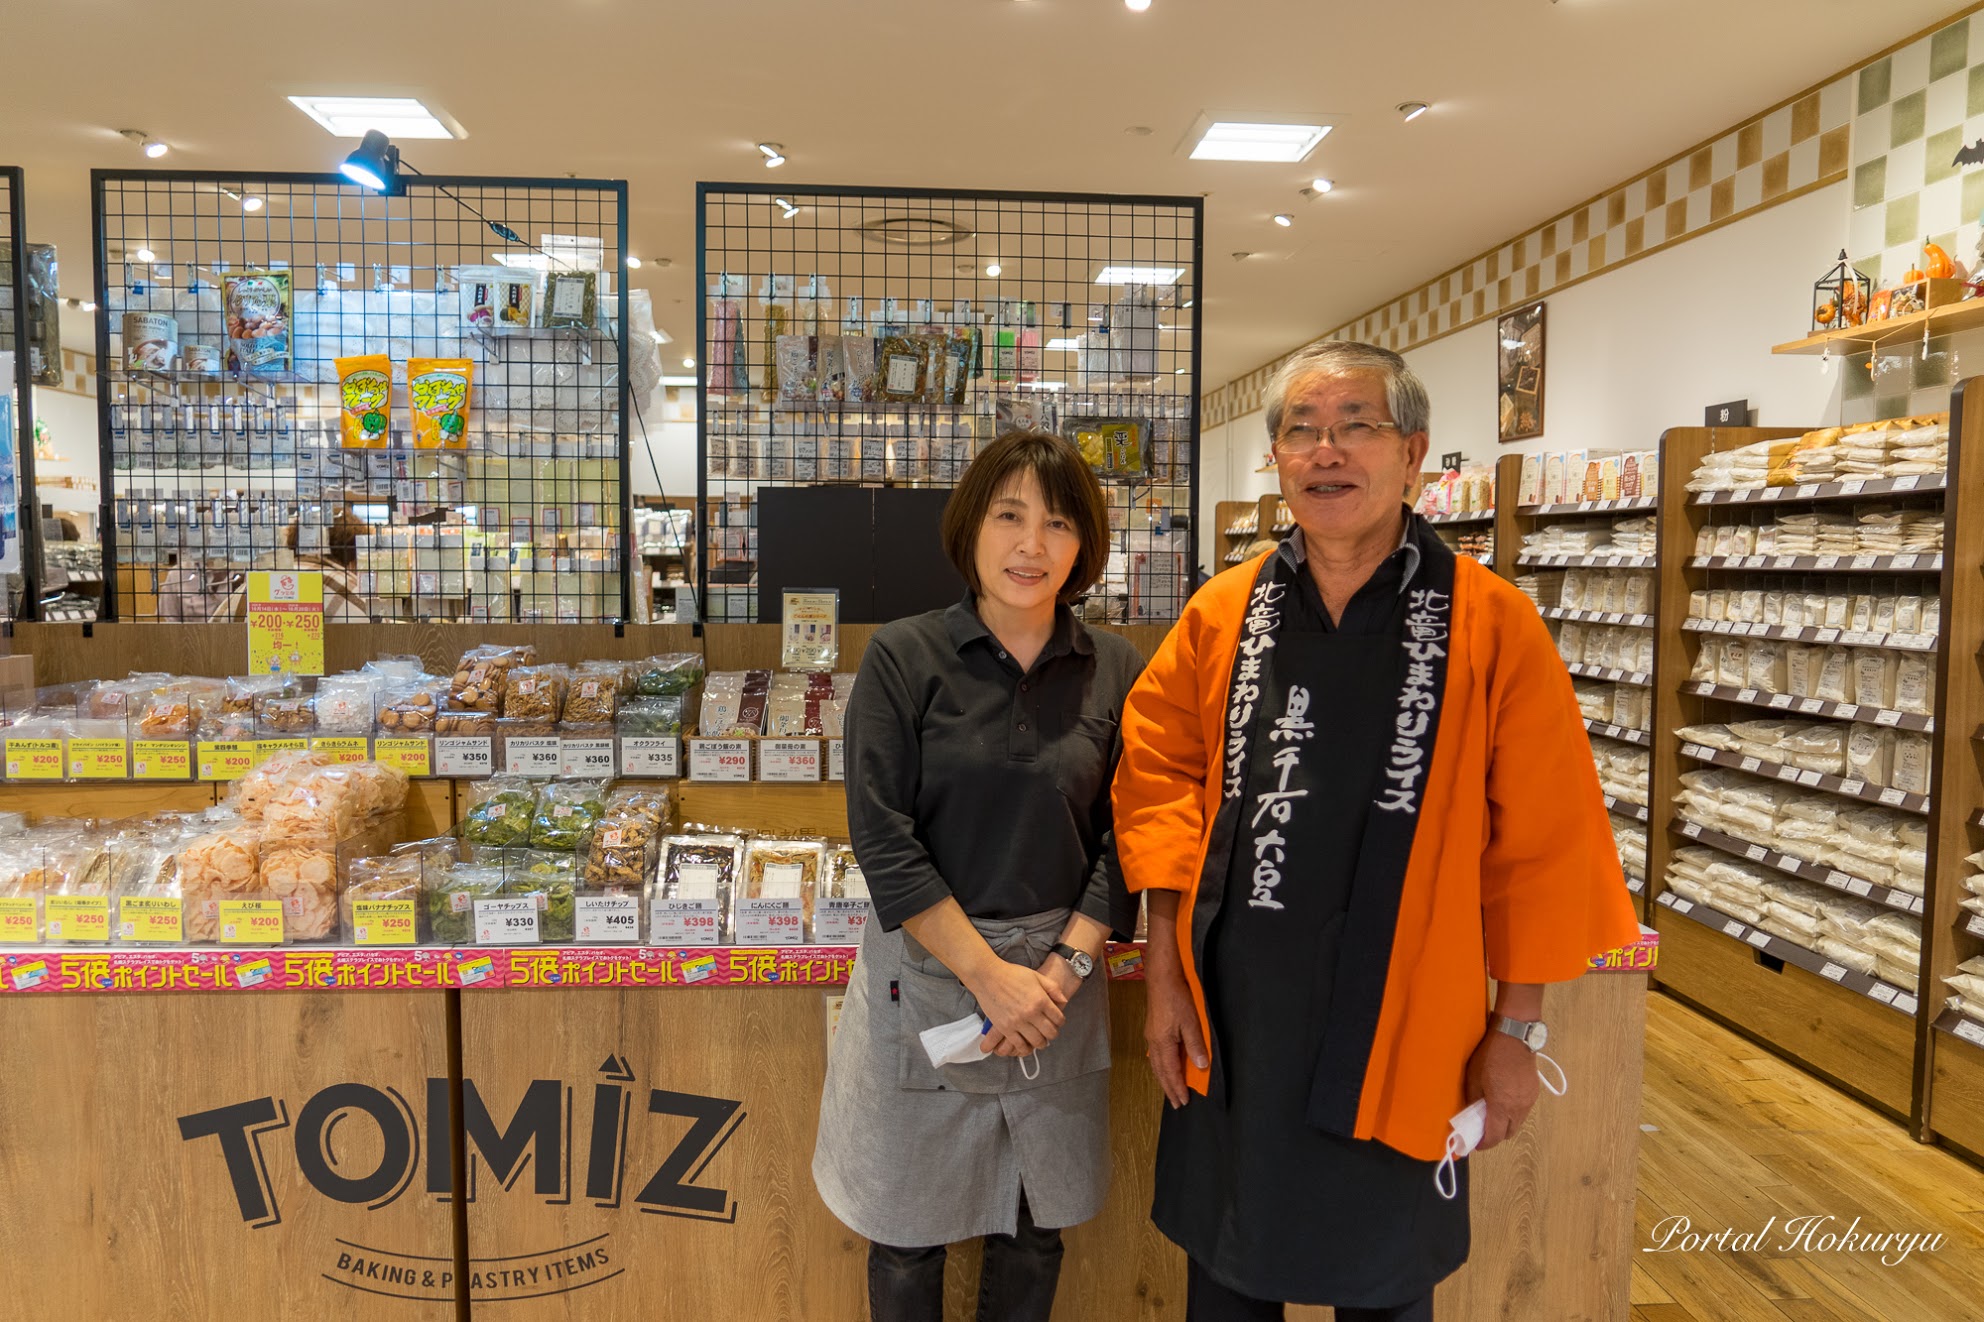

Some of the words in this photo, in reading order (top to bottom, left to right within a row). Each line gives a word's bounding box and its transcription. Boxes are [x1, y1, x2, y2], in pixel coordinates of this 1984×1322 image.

[133, 316, 168, 327] SABATON
[342, 377, 388, 394] かぼちゃ
[412, 380, 466, 396] かぼちゃ
[343, 393, 384, 409] フレーク
[414, 395, 464, 410] フレーク
[1720, 408, 1730, 423] 粉
[33, 756, 59, 764] ¥200
[96, 755, 122, 763] ¥250
[160, 756, 186, 764] ¥250
[338, 754, 364, 762] ¥200
[400, 753, 426, 762] ¥200
[462, 753, 488, 761] ¥350
[532, 753, 558, 761] ¥360
[585, 755, 610, 763] ¥360
[648, 754, 673, 762] ¥335
[719, 756, 746, 765] ¥290
[788, 756, 815, 765] ¥360
[225, 758, 250, 766] ¥200
[1248, 684, 1315, 910] 黒千石大豆
[484, 902, 529, 910] ゴーヤチップス
[586, 900, 629, 908] しいたけチップ
[5, 916, 33, 925] ¥250
[76, 914, 104, 923] ¥250
[150, 916, 177, 925] ¥250
[250, 917, 279, 926] ¥200
[506, 918, 534, 926] ¥330
[606, 916, 634, 924] ¥405
[684, 917, 714, 926] ¥398
[768, 916, 798, 926] ¥398
[382, 919, 411, 928] ¥250
[60, 960, 233, 988] 5倍ポイントセール
[285, 959, 455, 986] 5倍ポイントセール
[510, 956, 678, 984] 5倍ポイントセール
[177, 1052, 747, 1229] TOMIZ
[336, 1252, 416, 1287] BAKING
[422, 1269, 436, 1288] &
[442, 1267, 540, 1289] PASTRY
[544, 1248, 610, 1281] ITEMS
